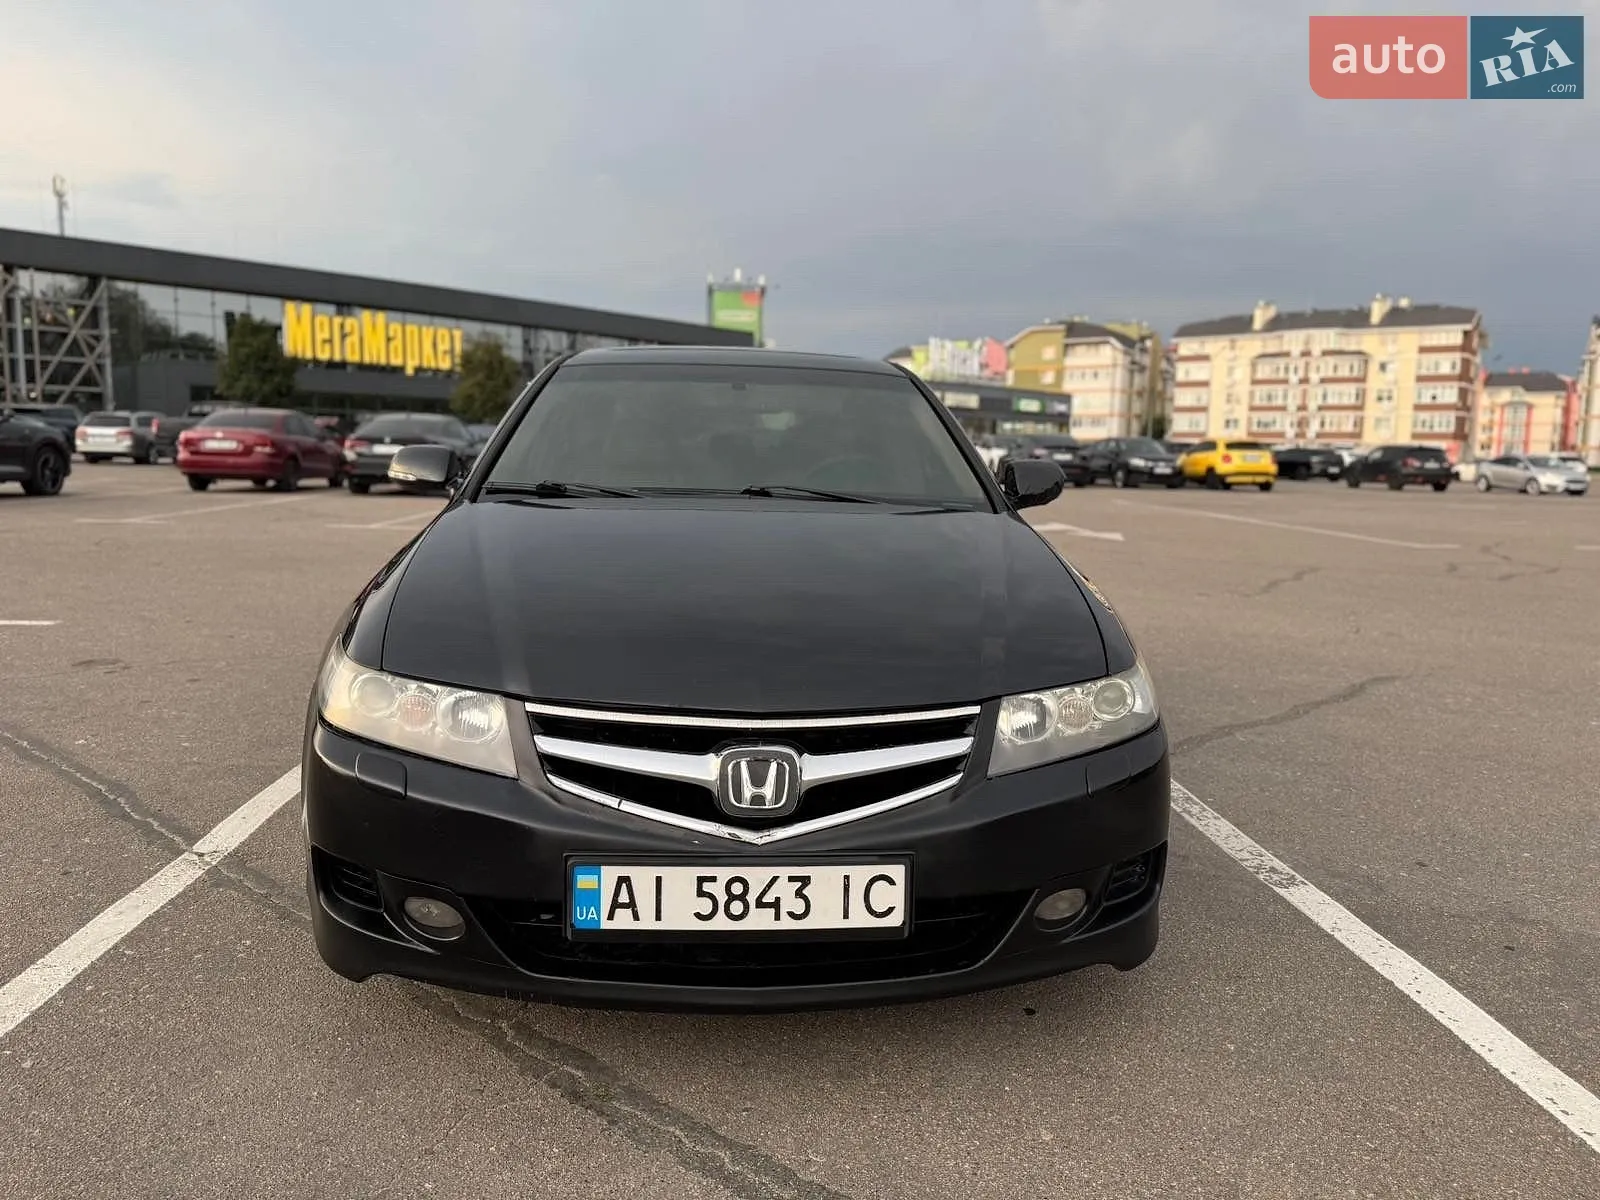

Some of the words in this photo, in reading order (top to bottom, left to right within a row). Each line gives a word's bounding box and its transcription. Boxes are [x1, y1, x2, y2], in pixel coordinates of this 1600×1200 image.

[283, 300, 463, 376] МегаМаркет
[576, 906, 599, 921] UA
[606, 875, 663, 921] AI
[693, 875, 812, 922] 5843
[842, 873, 897, 920] IC
